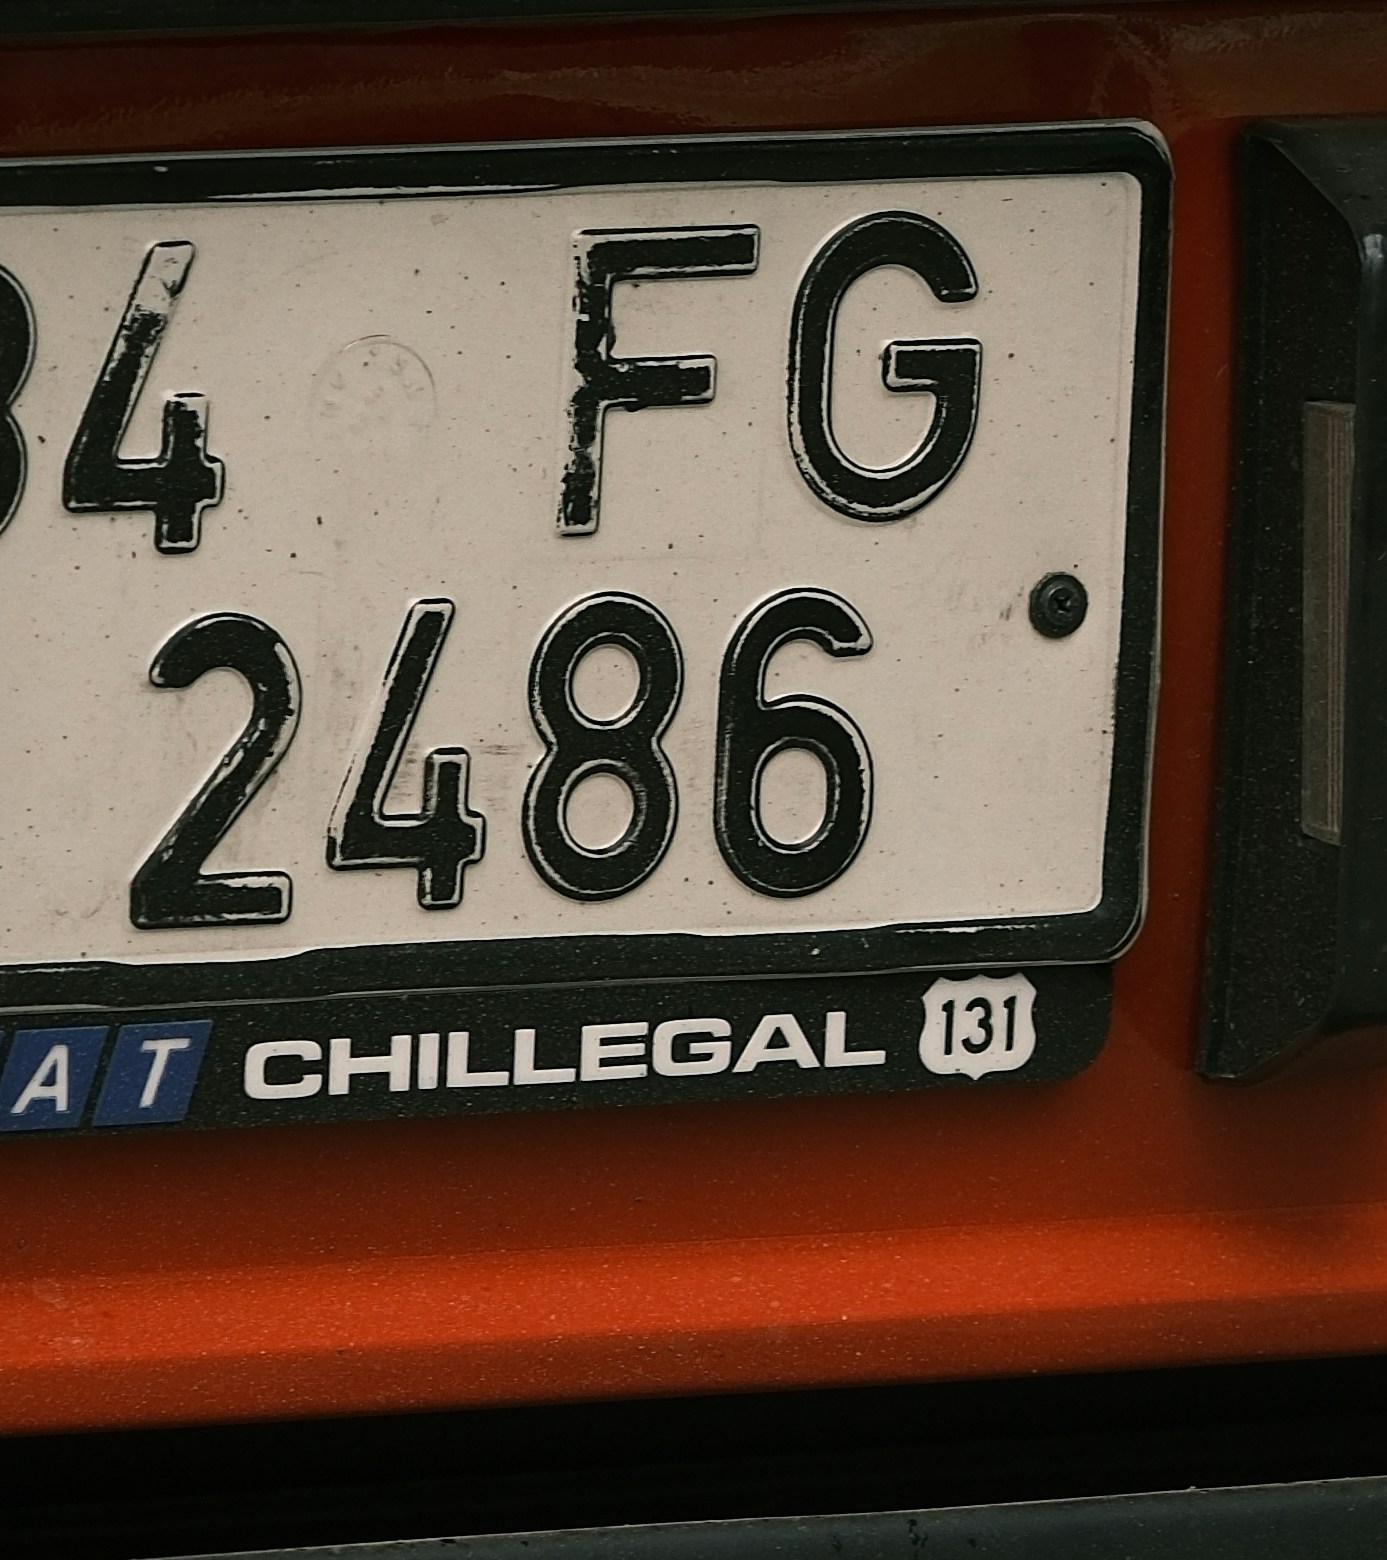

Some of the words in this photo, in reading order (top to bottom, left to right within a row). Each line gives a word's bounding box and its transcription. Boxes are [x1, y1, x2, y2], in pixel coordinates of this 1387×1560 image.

[0, 240, 225, 555] 4
[556, 210, 984, 537] FG
[130, 586, 873, 930] 2486
[243, 1010, 887, 1100] CHILLEGAL
[940, 994, 1019, 1057] 131
